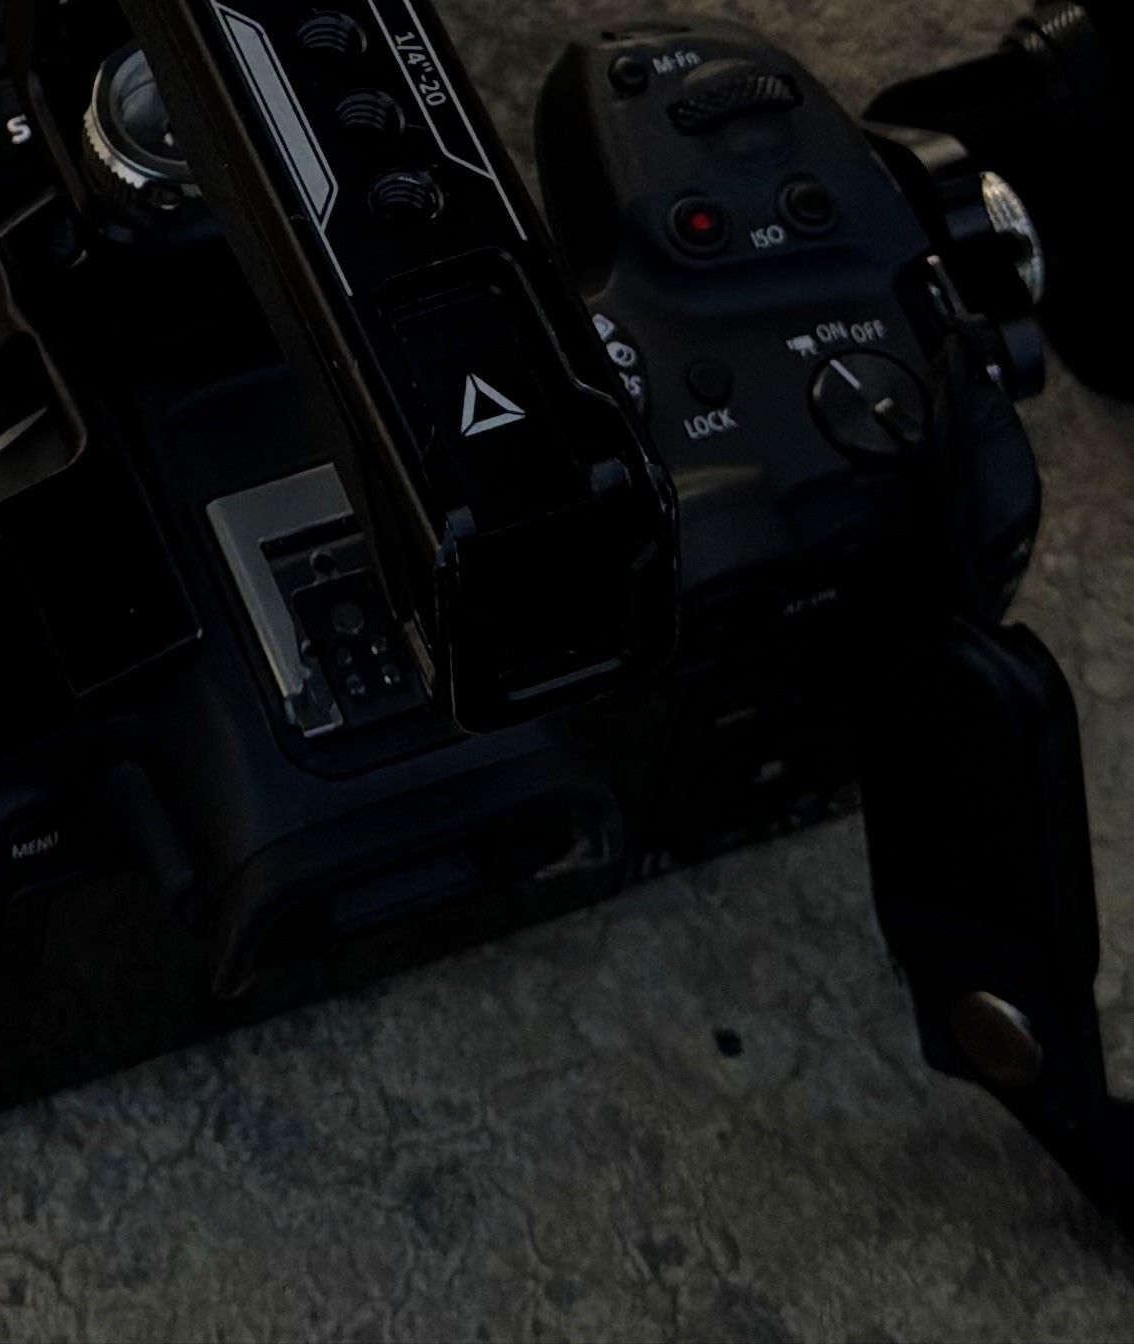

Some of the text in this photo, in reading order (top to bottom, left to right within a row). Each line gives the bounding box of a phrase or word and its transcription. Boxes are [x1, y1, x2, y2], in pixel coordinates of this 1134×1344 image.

[394, 31, 447, 107] 1/4"-20
[750, 225, 786, 249] ISO
[816, 319, 889, 343] ON OFF
[683, 407, 738, 440] LOCK
[11, 828, 60, 861] MENU
